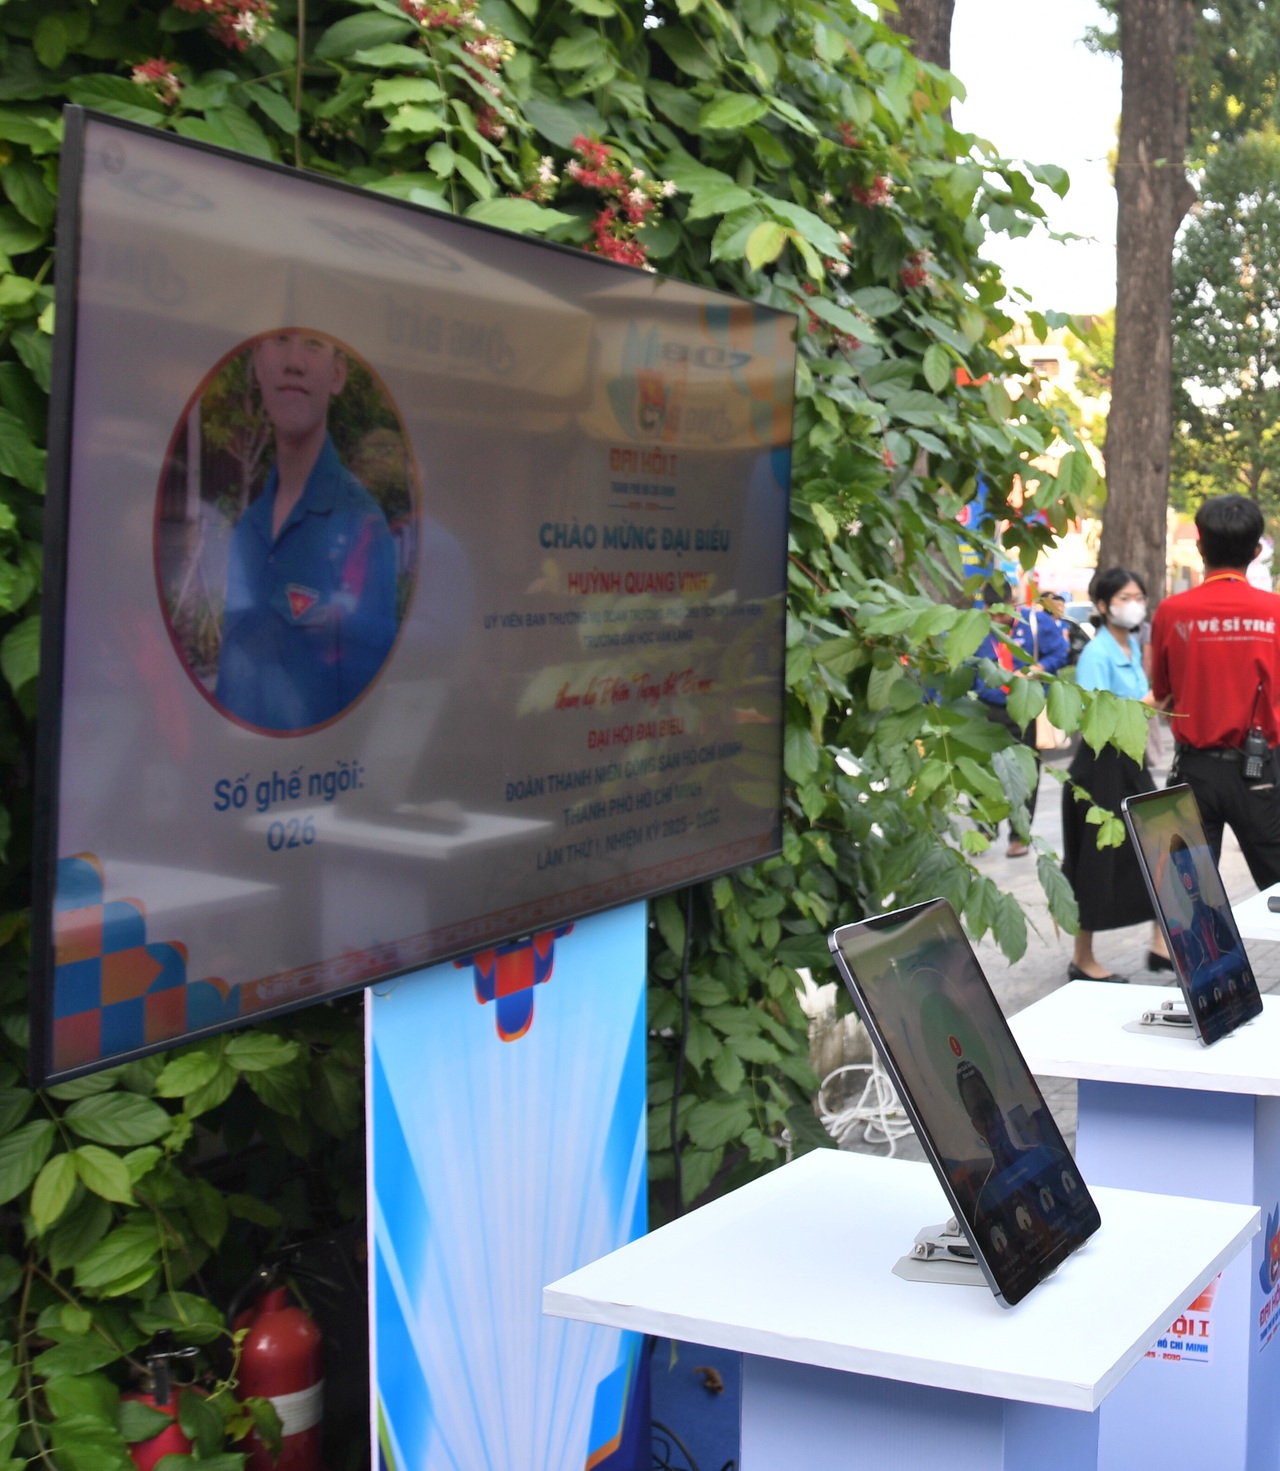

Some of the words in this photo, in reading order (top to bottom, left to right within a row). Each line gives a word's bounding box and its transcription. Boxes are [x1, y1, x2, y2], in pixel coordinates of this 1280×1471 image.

[539, 517, 597, 549] CHÀO
[603, 517, 657, 550] MỪNG
[661, 527, 690, 557] ĐẠI
[695, 520, 731, 552] BIỂU
[567, 567, 621, 595] HUỲNH
[624, 571, 675, 594] QUANG
[677, 571, 709, 592] VINH
[526, 612, 546, 627] BAN
[1197, 617, 1220, 634] VỆ
[1222, 617, 1240, 633] SĨ
[1243, 618, 1275, 634] TRẺ
[588, 728, 609, 752] ĐẠI
[213, 773, 250, 811] Số
[255, 765, 303, 813] ghế
[308, 760, 365, 801] ngồi:
[505, 775, 545, 802] ĐOÀN
[547, 769, 592, 795] THANH
[267, 815, 316, 851] 026
[1165, 1315, 1195, 1338] ỘI
[1198, 1320, 1210, 1337] I
[1157, 1337, 1168, 1349] HỒ
[1170, 1340, 1183, 1350] CHÍ
[1186, 1342, 1208, 1353] MINH
[1162, 1352, 1181, 1361] 2030
